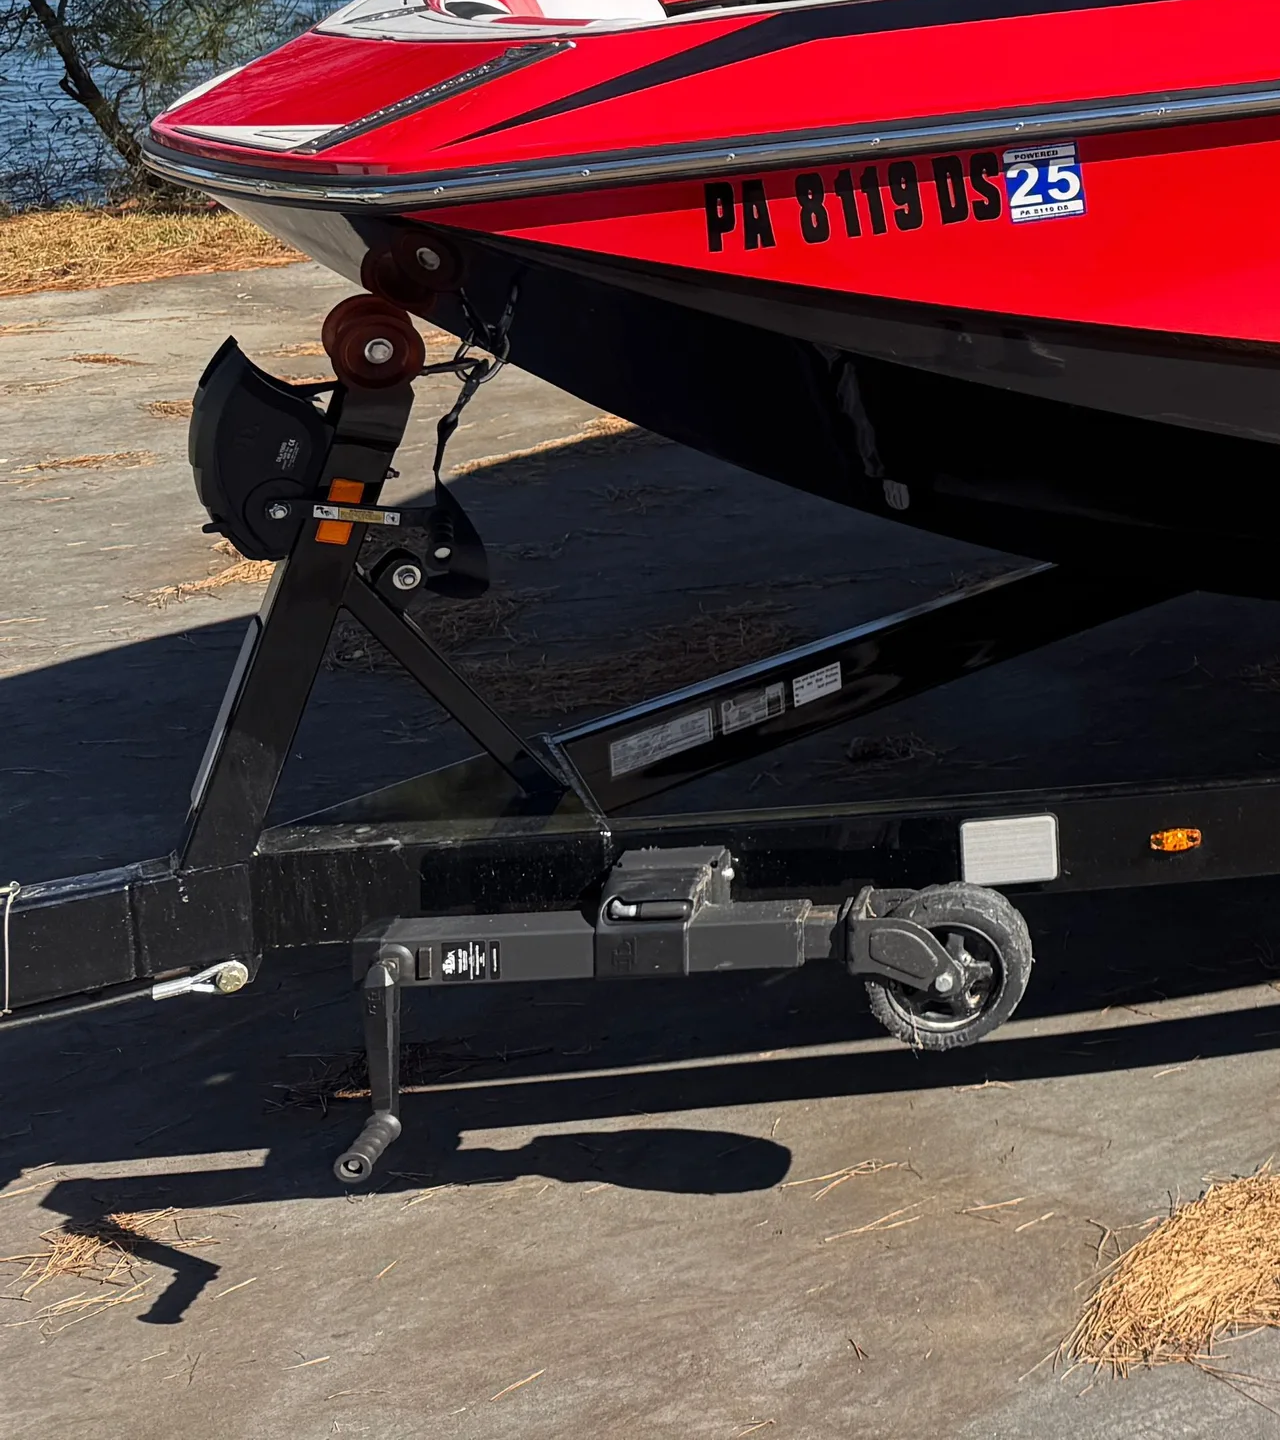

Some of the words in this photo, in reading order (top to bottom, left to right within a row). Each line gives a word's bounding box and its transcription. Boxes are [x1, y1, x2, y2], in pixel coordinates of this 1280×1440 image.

[1014, 150, 1059, 160] POWERED
[704, 179, 776, 253] PA
[795, 161, 924, 245] 8119
[932, 152, 1002, 225] DS
[1006, 157, 1080, 206] 25
